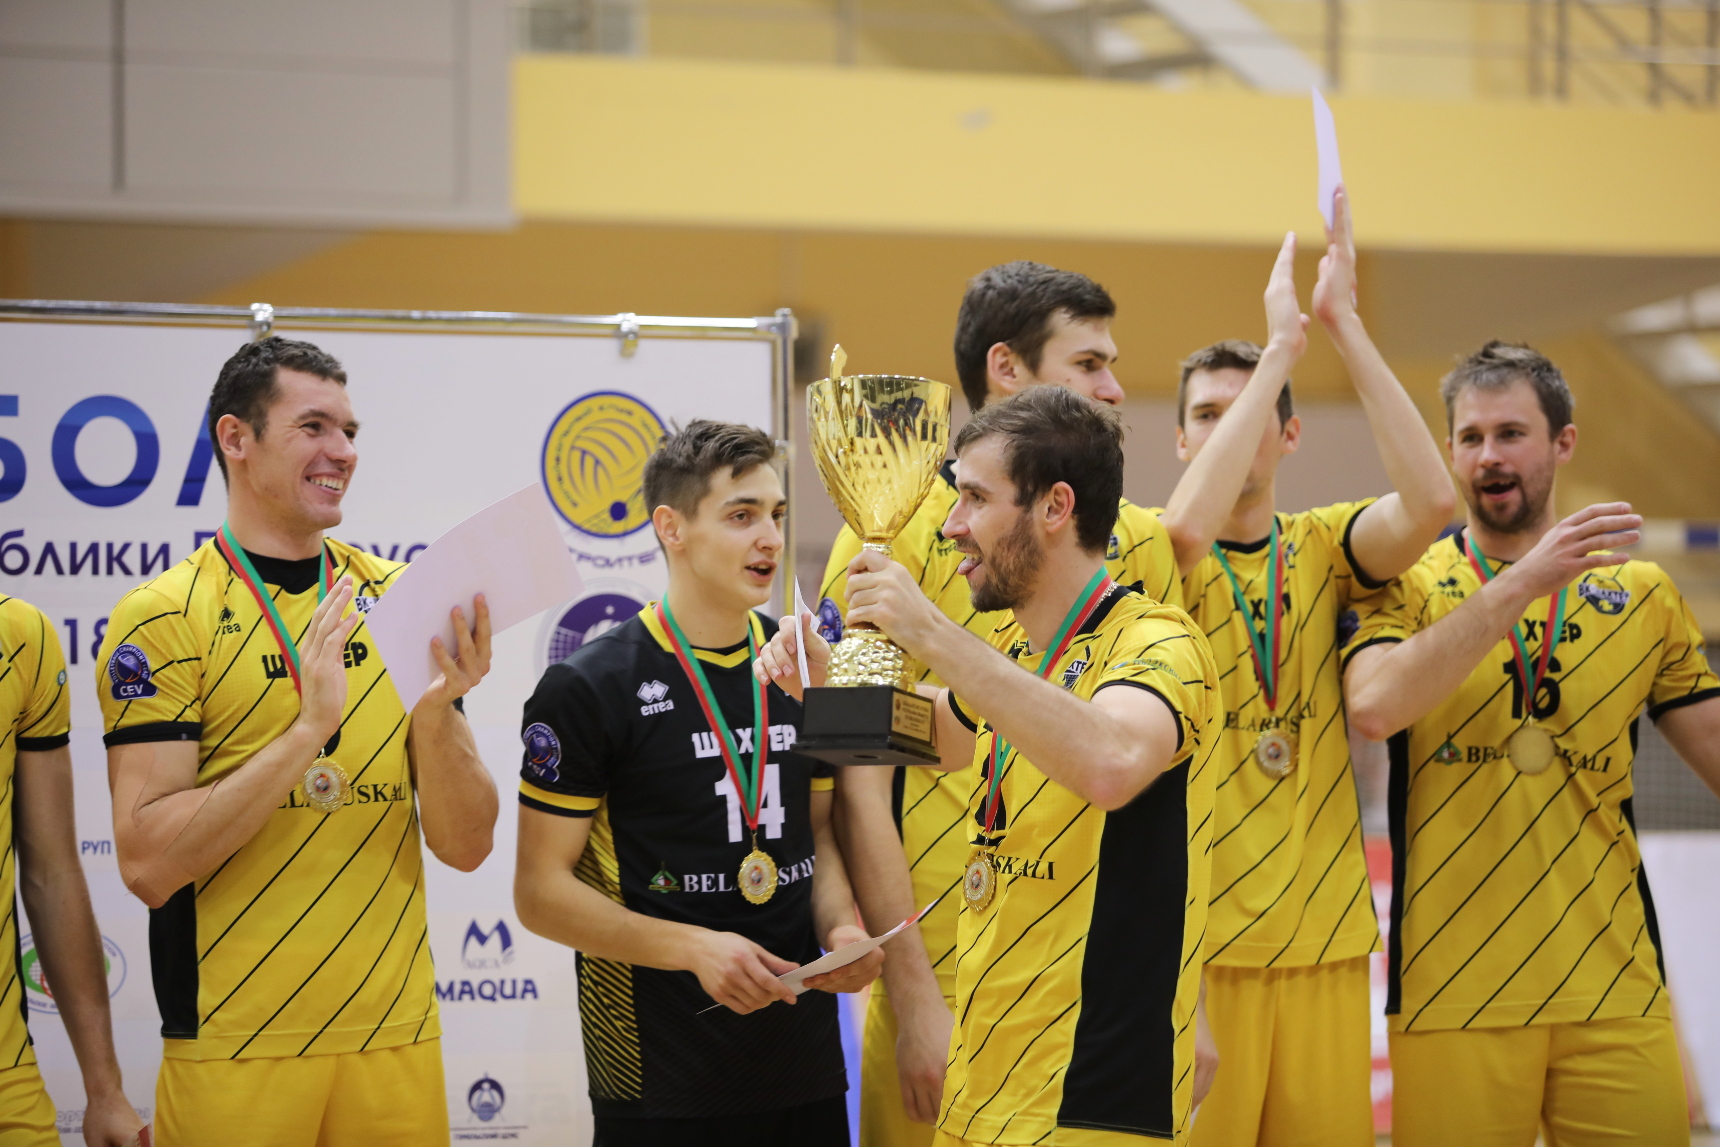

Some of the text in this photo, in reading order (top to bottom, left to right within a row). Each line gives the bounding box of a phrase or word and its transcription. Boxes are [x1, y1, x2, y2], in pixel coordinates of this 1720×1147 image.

[119, 684, 143, 696] CEV
[1503, 656, 1562, 719] 16
[640, 699, 675, 716] errea
[714, 763, 786, 843] 14
[81, 840, 112, 855] РУП
[435, 979, 539, 1002] MAQUA
